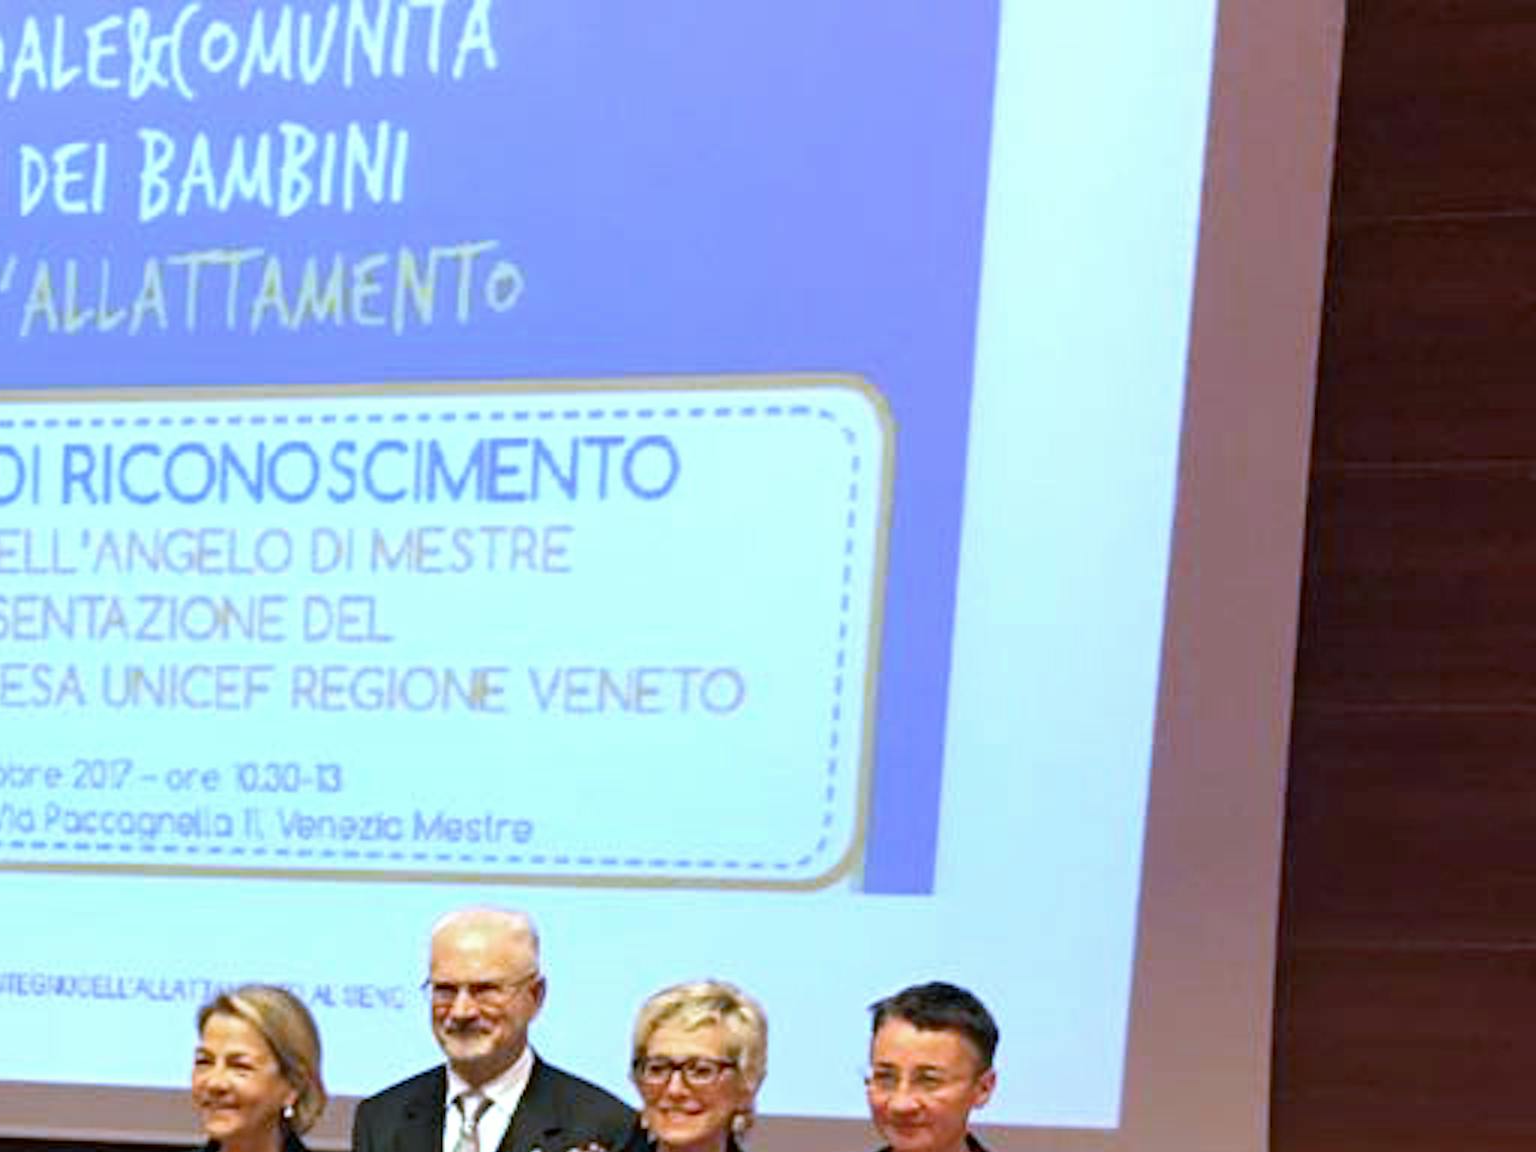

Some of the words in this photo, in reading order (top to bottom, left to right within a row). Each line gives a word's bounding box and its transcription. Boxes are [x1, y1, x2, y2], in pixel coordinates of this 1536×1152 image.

[19, 142, 107, 216] DEI
[138, 121, 410, 222] BAMBINI
[62, 434, 681, 506] RICONOSCIMENTO
[310, 526, 354, 574] DI
[370, 524, 574, 574] MESTRE
[302, 594, 395, 642] DEL
[100, 664, 275, 711] UNICEF
[290, 664, 511, 713] REGIONE
[526, 666, 747, 714] VENETO
[72, 759, 134, 790] 2017
